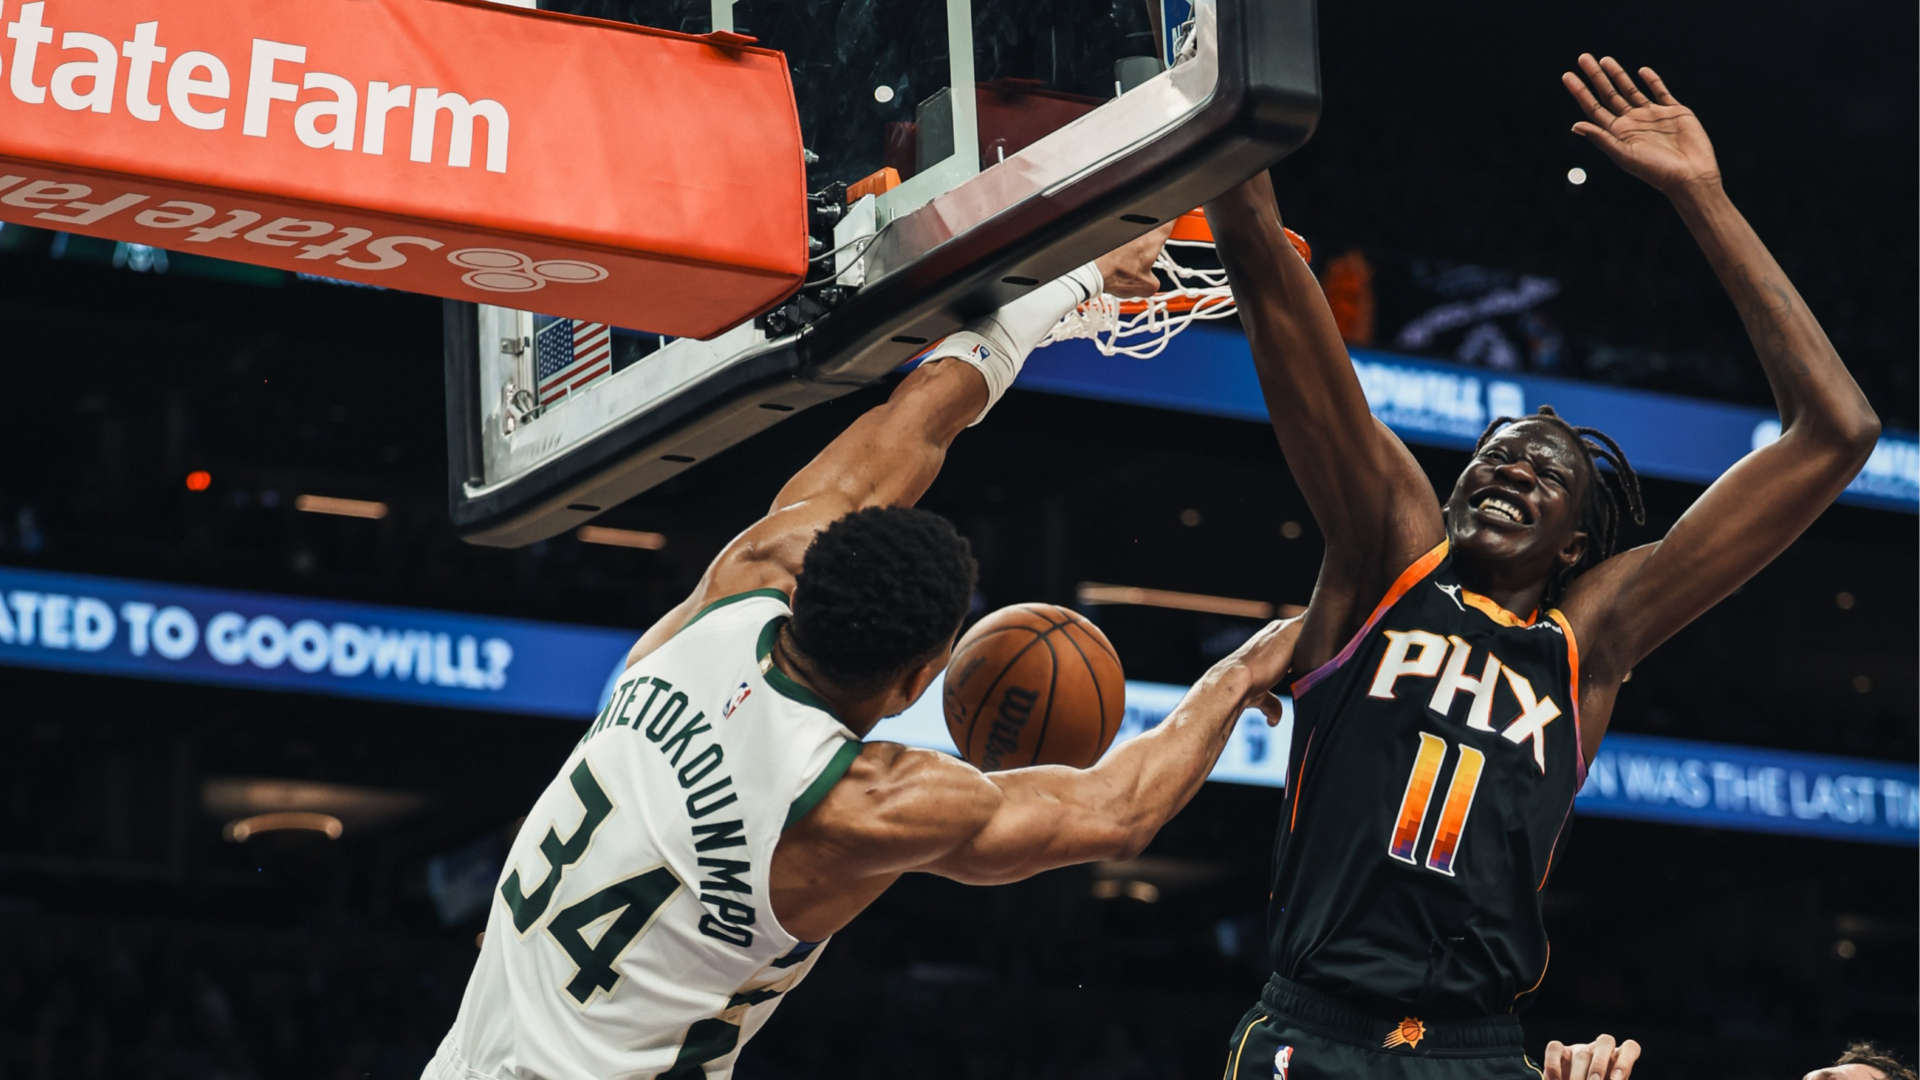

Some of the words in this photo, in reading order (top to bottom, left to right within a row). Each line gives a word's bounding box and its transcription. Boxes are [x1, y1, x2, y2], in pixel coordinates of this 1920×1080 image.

[0, 1, 230, 130] tate
[121, 602, 199, 660] TO
[205, 611, 514, 690] GOODWILL?
[1368, 629, 1562, 776] PHX
[1388, 731, 1486, 877] 11
[1617, 754, 1711, 809] WAS
[1711, 761, 1788, 817] THE
[1789, 770, 1876, 824] LAST
[499, 757, 684, 1008] 34
